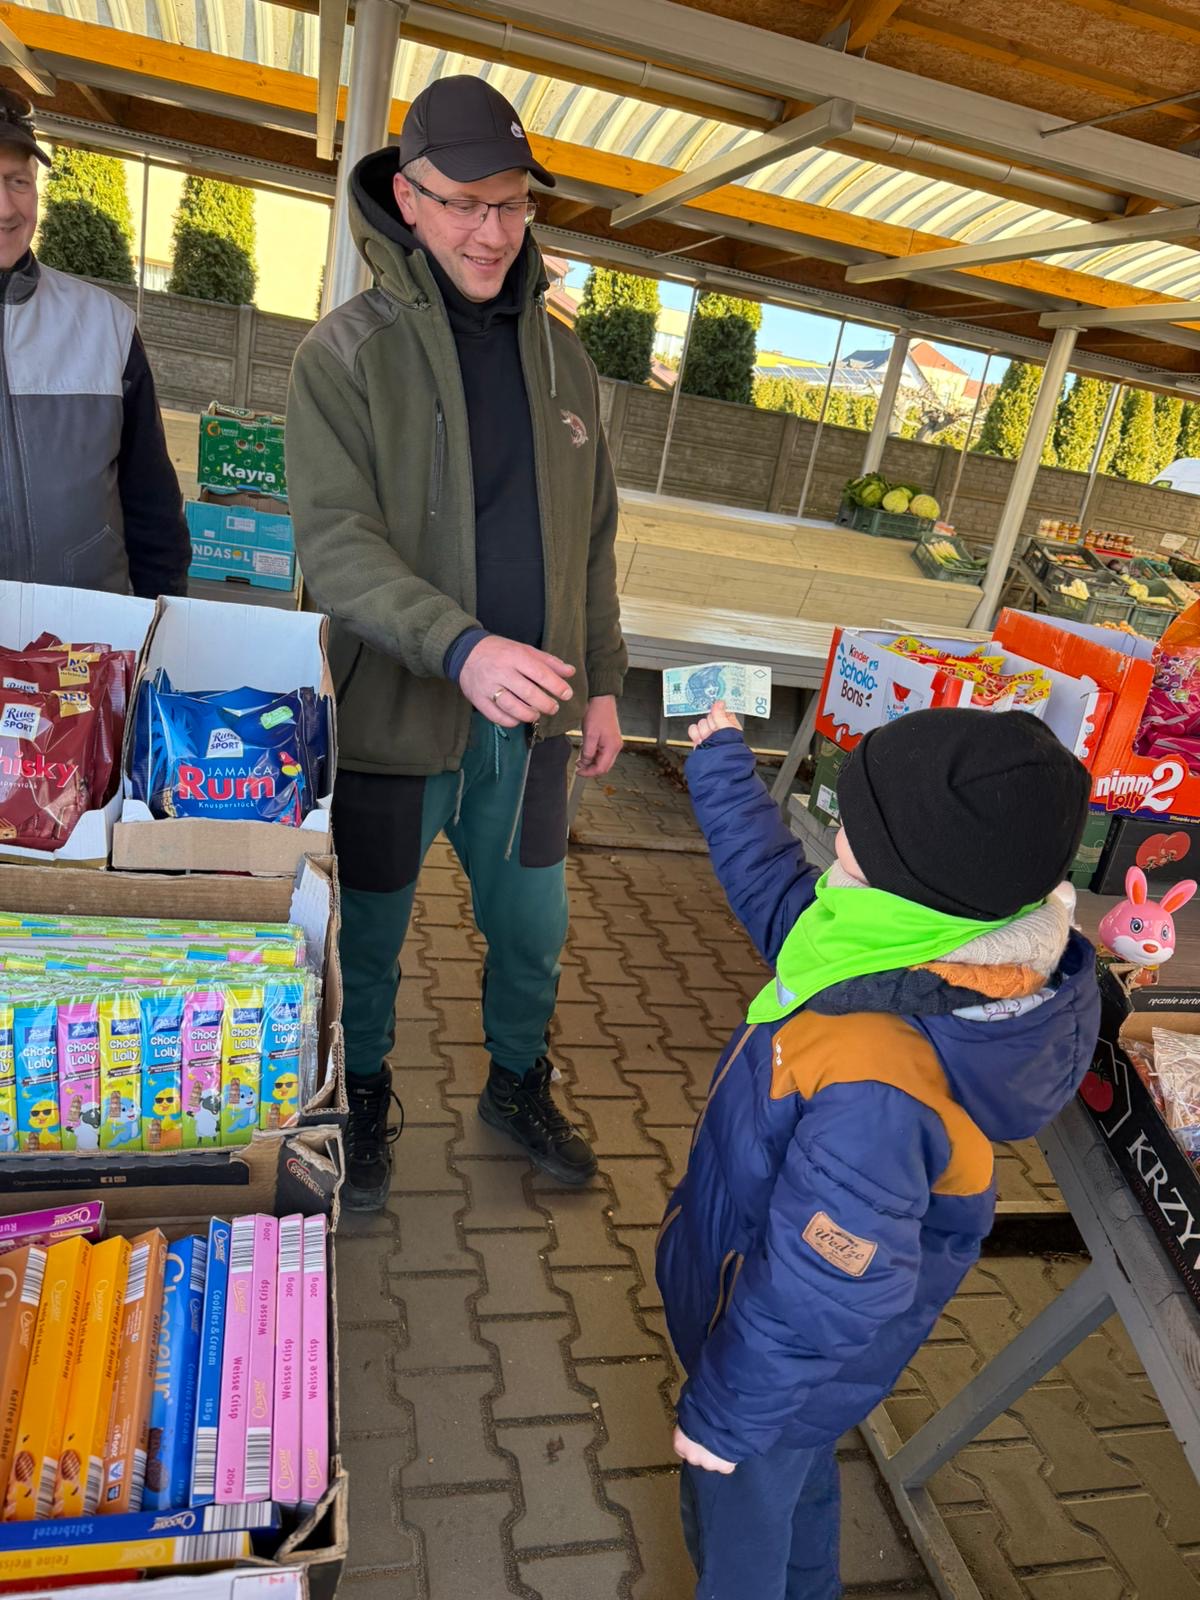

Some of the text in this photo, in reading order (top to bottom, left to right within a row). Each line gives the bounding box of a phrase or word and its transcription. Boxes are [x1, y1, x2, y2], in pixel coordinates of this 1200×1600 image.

[222, 462, 276, 483] Kayra
[192, 543, 250, 562] NDASOL
[755, 696, 767, 715] 50
[841, 680, 863, 707] Bons
[3, 719, 33, 732] SPORT
[6, 707, 36, 723] Ritter
[210, 740, 240, 750] SPORT
[0, 746, 79, 788] hisky
[207, 766, 272, 777] JAMAICA
[177, 764, 276, 800] Rum
[1106, 790, 1146, 813] Lolly
[1178, 997, 1200, 1006] sorto
[1126, 1129, 1200, 1269] KRZY
[258, 1279, 271, 1336] Weisse Crisp
[208, 1290, 223, 1366] Cookies & Cream
[63, 1351, 73, 1379] Honig
[105, 1351, 116, 1379] Honig
[281, 1338, 294, 1400] Weisse Crisp
[307, 1338, 320, 1400] Weisse Crisp
[229, 1356, 243, 1420] Weisse Crisp
[6, 1388, 19, 1425] Kaffee
[33, 1523, 94, 1540] Salzbrezel
[0, 1554, 69, 1571] Feine Weiss
